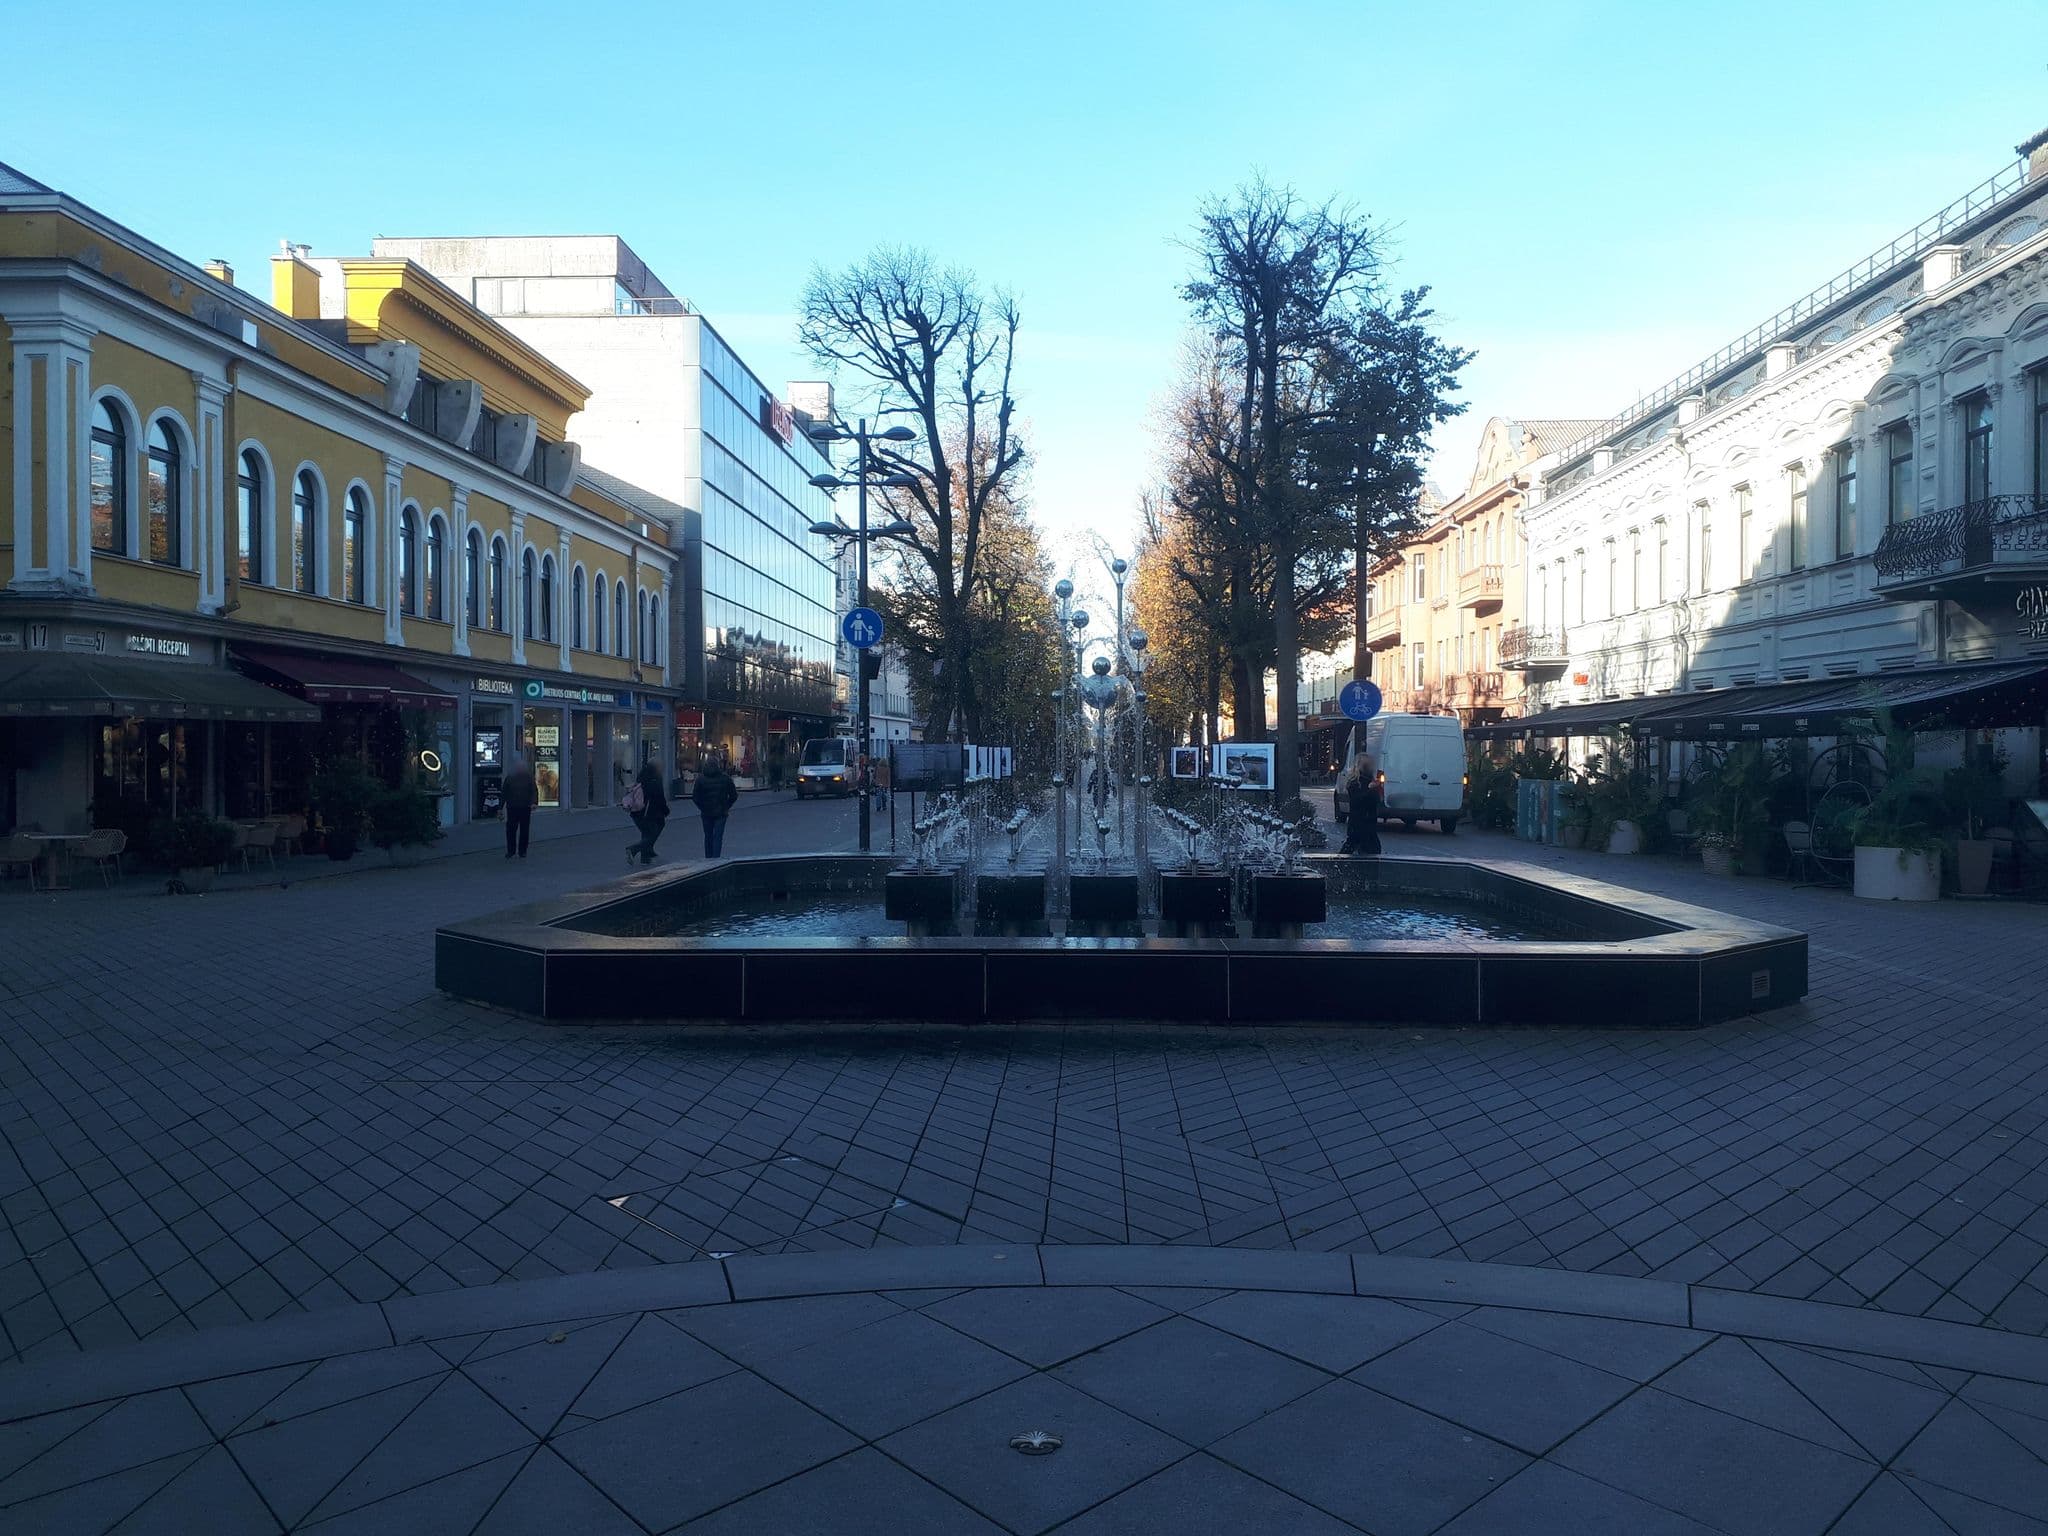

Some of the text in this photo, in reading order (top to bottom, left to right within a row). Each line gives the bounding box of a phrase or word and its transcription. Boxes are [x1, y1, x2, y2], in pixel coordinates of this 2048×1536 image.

[32, 624, 47, 647] 17
[96, 631, 106, 652] 57
[158, 639, 189, 656] RECEPTAI
[478, 678, 514, 695] BIBLIOTEKA
